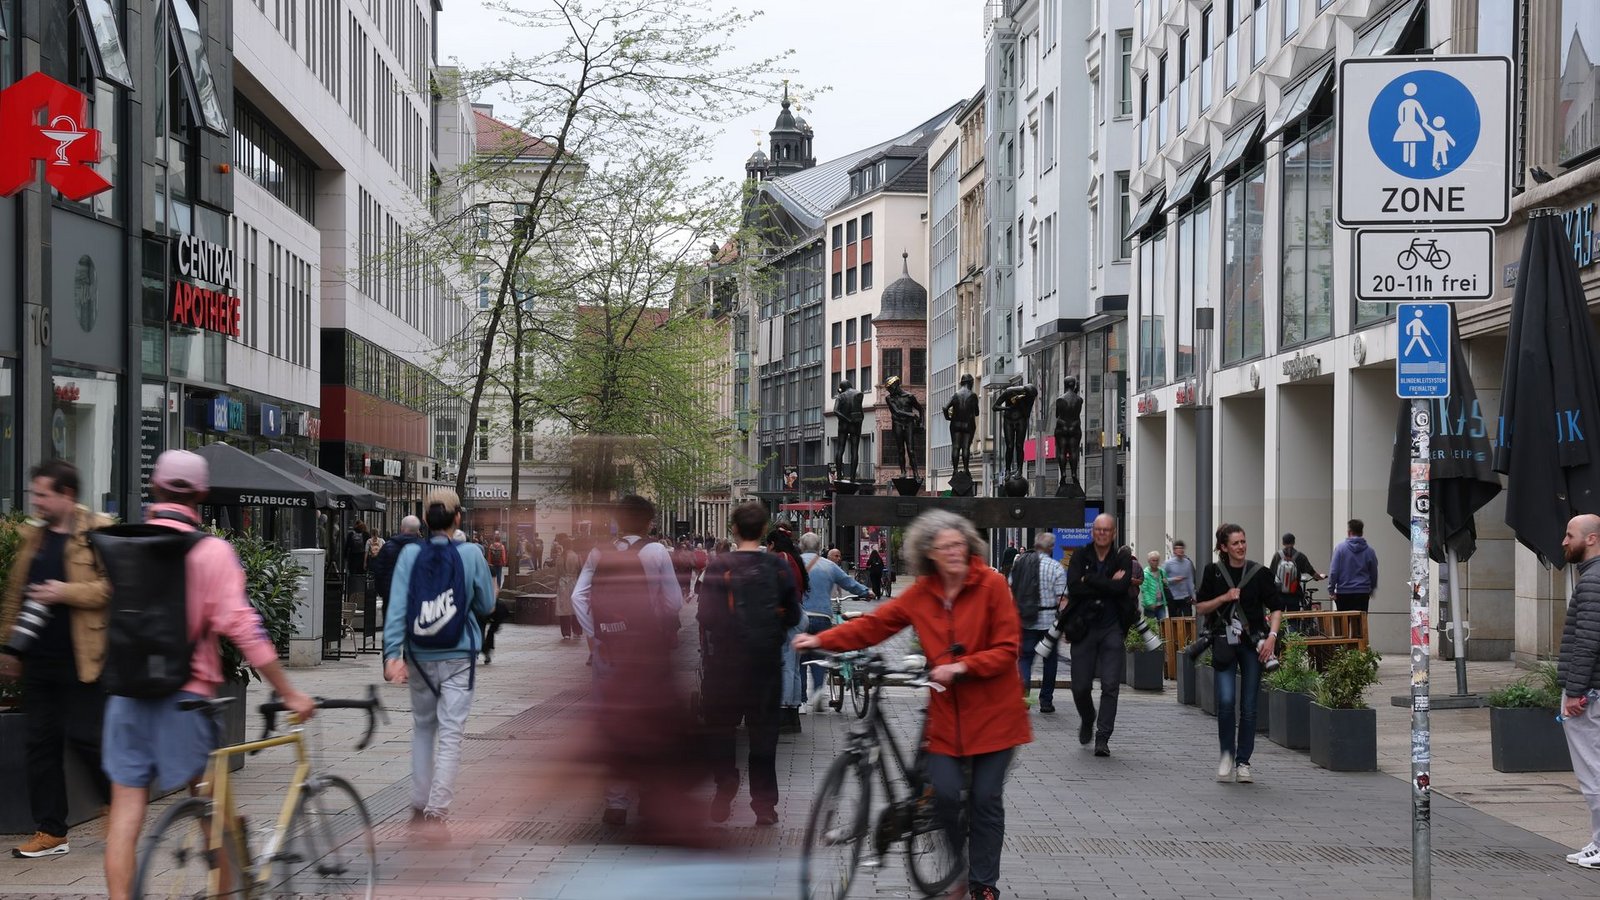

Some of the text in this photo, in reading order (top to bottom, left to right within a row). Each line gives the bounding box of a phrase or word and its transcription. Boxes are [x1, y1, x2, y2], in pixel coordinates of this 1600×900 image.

[1381, 186, 1465, 213] ZONE
[178, 233, 238, 290] CENTRAL
[1372, 273, 1477, 292] 20-11h frei
[31, 307, 50, 346] 16
[173, 280, 241, 337] APOTHEKE
[239, 494, 308, 507] STARBUCKS
[419, 588, 457, 625] NIKE
